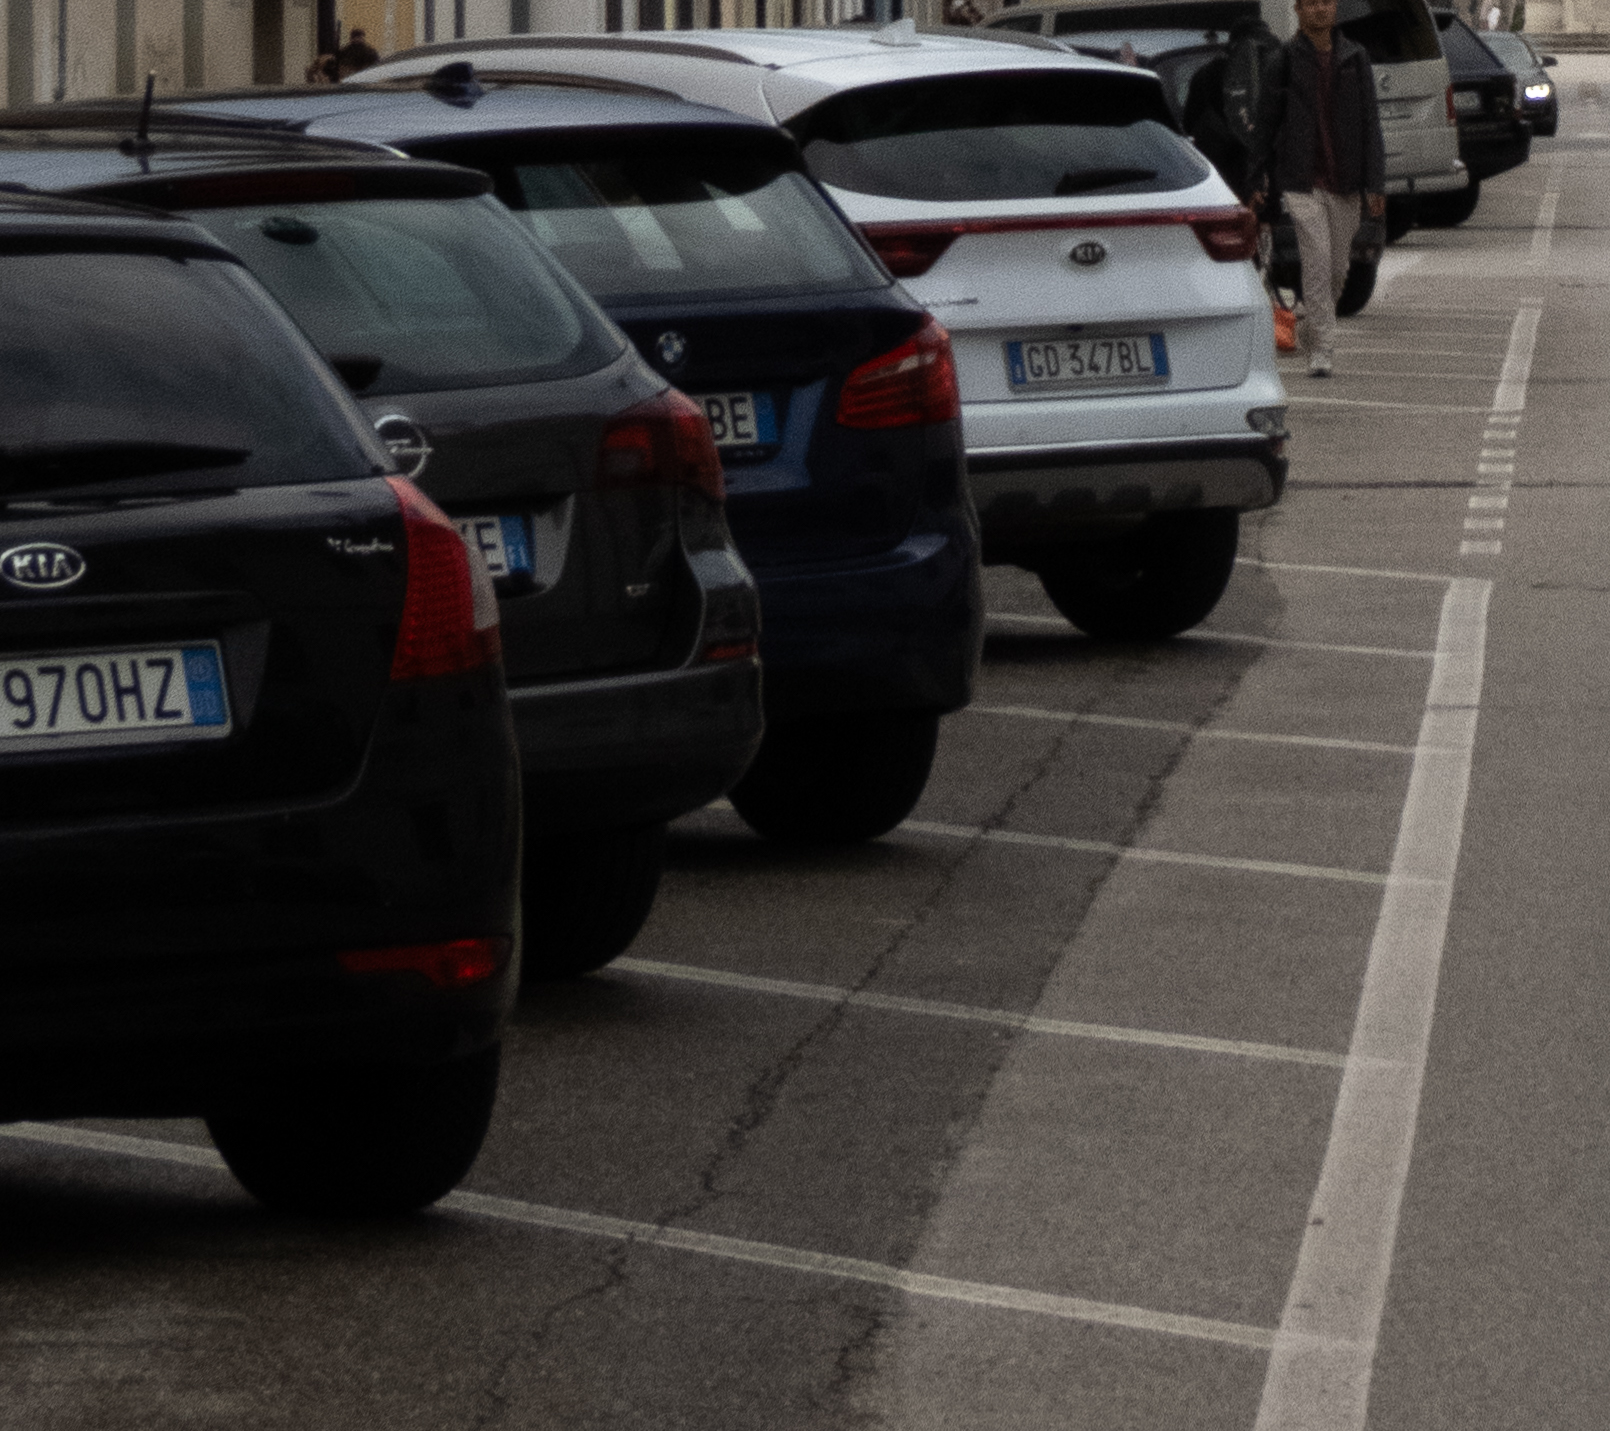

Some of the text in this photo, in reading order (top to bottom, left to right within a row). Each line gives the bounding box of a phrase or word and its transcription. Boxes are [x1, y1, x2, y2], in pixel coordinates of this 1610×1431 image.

[1026, 345, 1060, 378] GD
[12, 552, 73, 579] KIA
[3, 657, 183, 730] 970HZ
